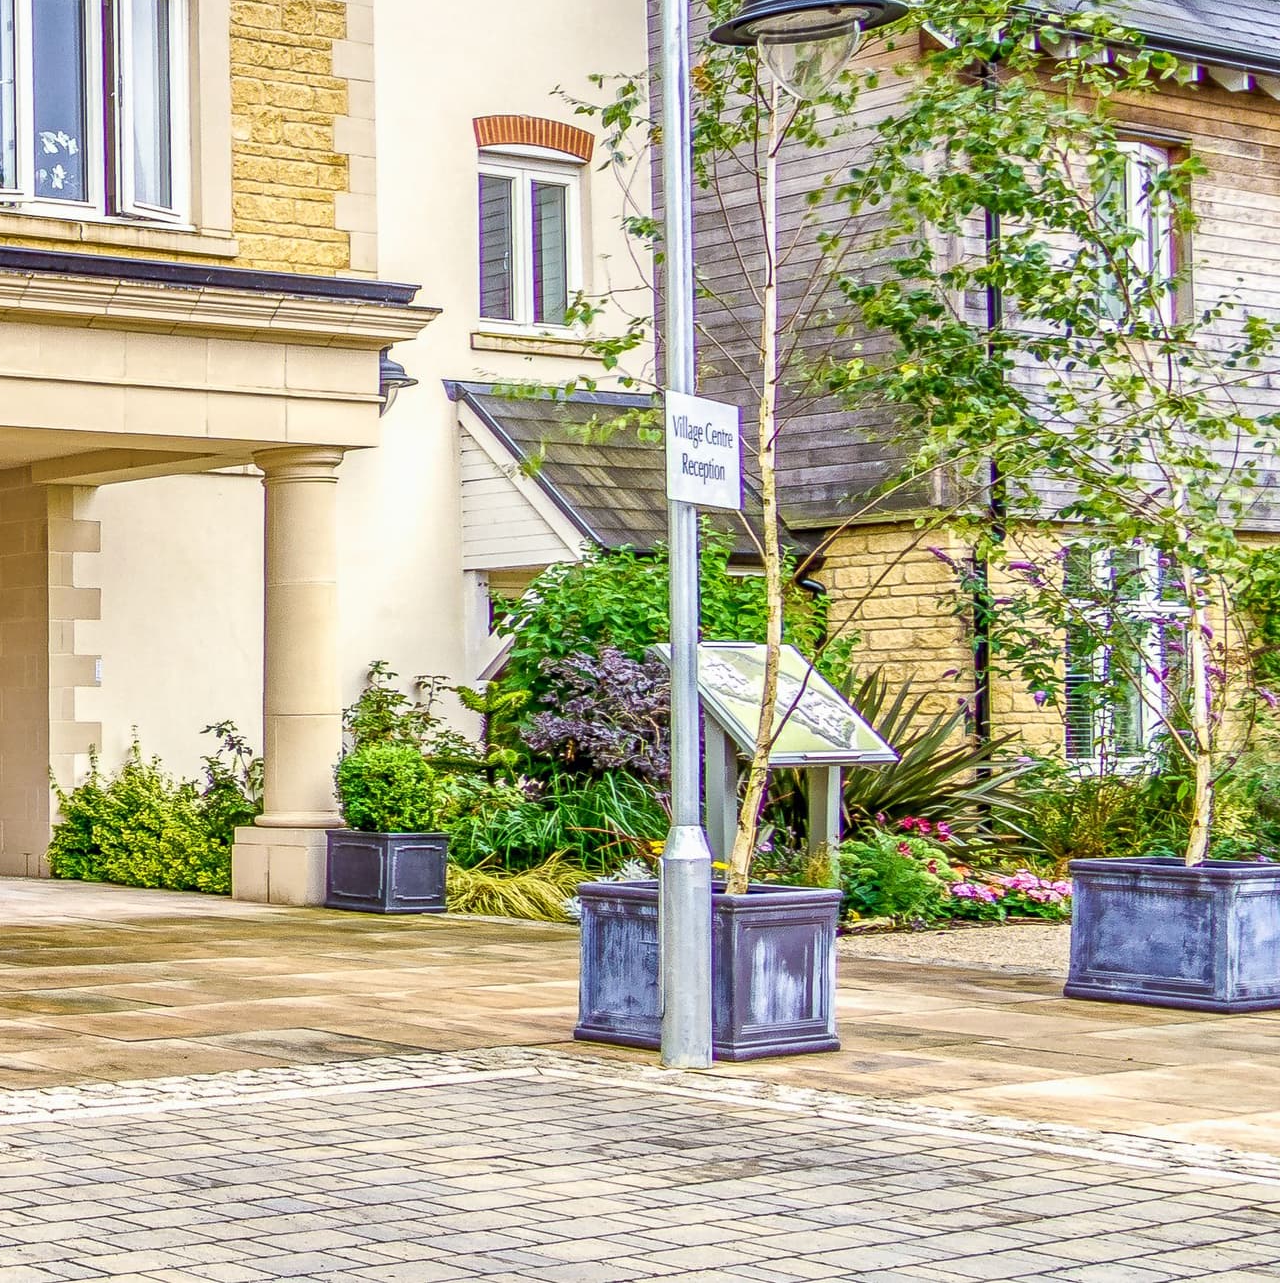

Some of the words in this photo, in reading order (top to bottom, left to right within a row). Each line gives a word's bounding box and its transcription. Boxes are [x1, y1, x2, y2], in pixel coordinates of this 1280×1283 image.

[672, 414, 703, 449] Village
[705, 421, 734, 449] Centre
[681, 453, 726, 485] Reception
